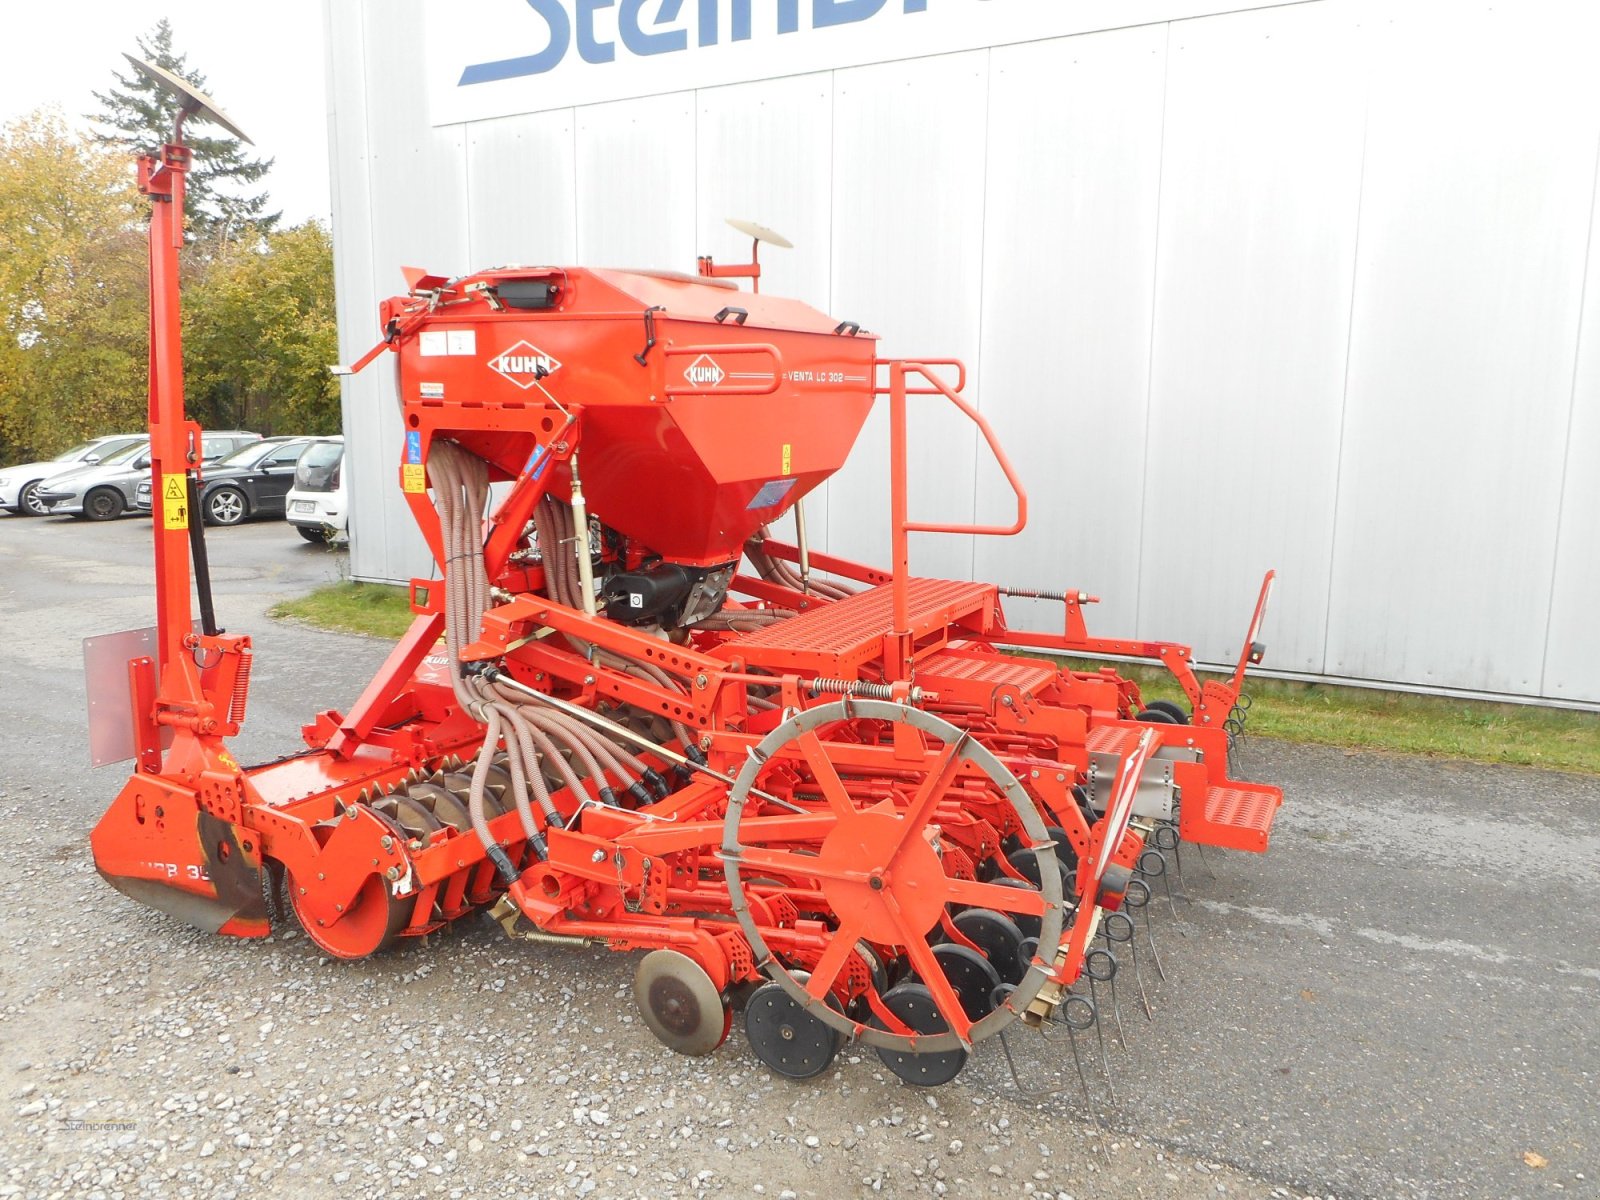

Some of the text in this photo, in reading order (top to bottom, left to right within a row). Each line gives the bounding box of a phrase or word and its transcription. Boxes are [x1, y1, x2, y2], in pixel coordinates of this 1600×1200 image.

[499, 356, 550, 373] KUHN
[690, 366, 719, 382] KUHN
[788, 371, 844, 382] VENTA LC 302
